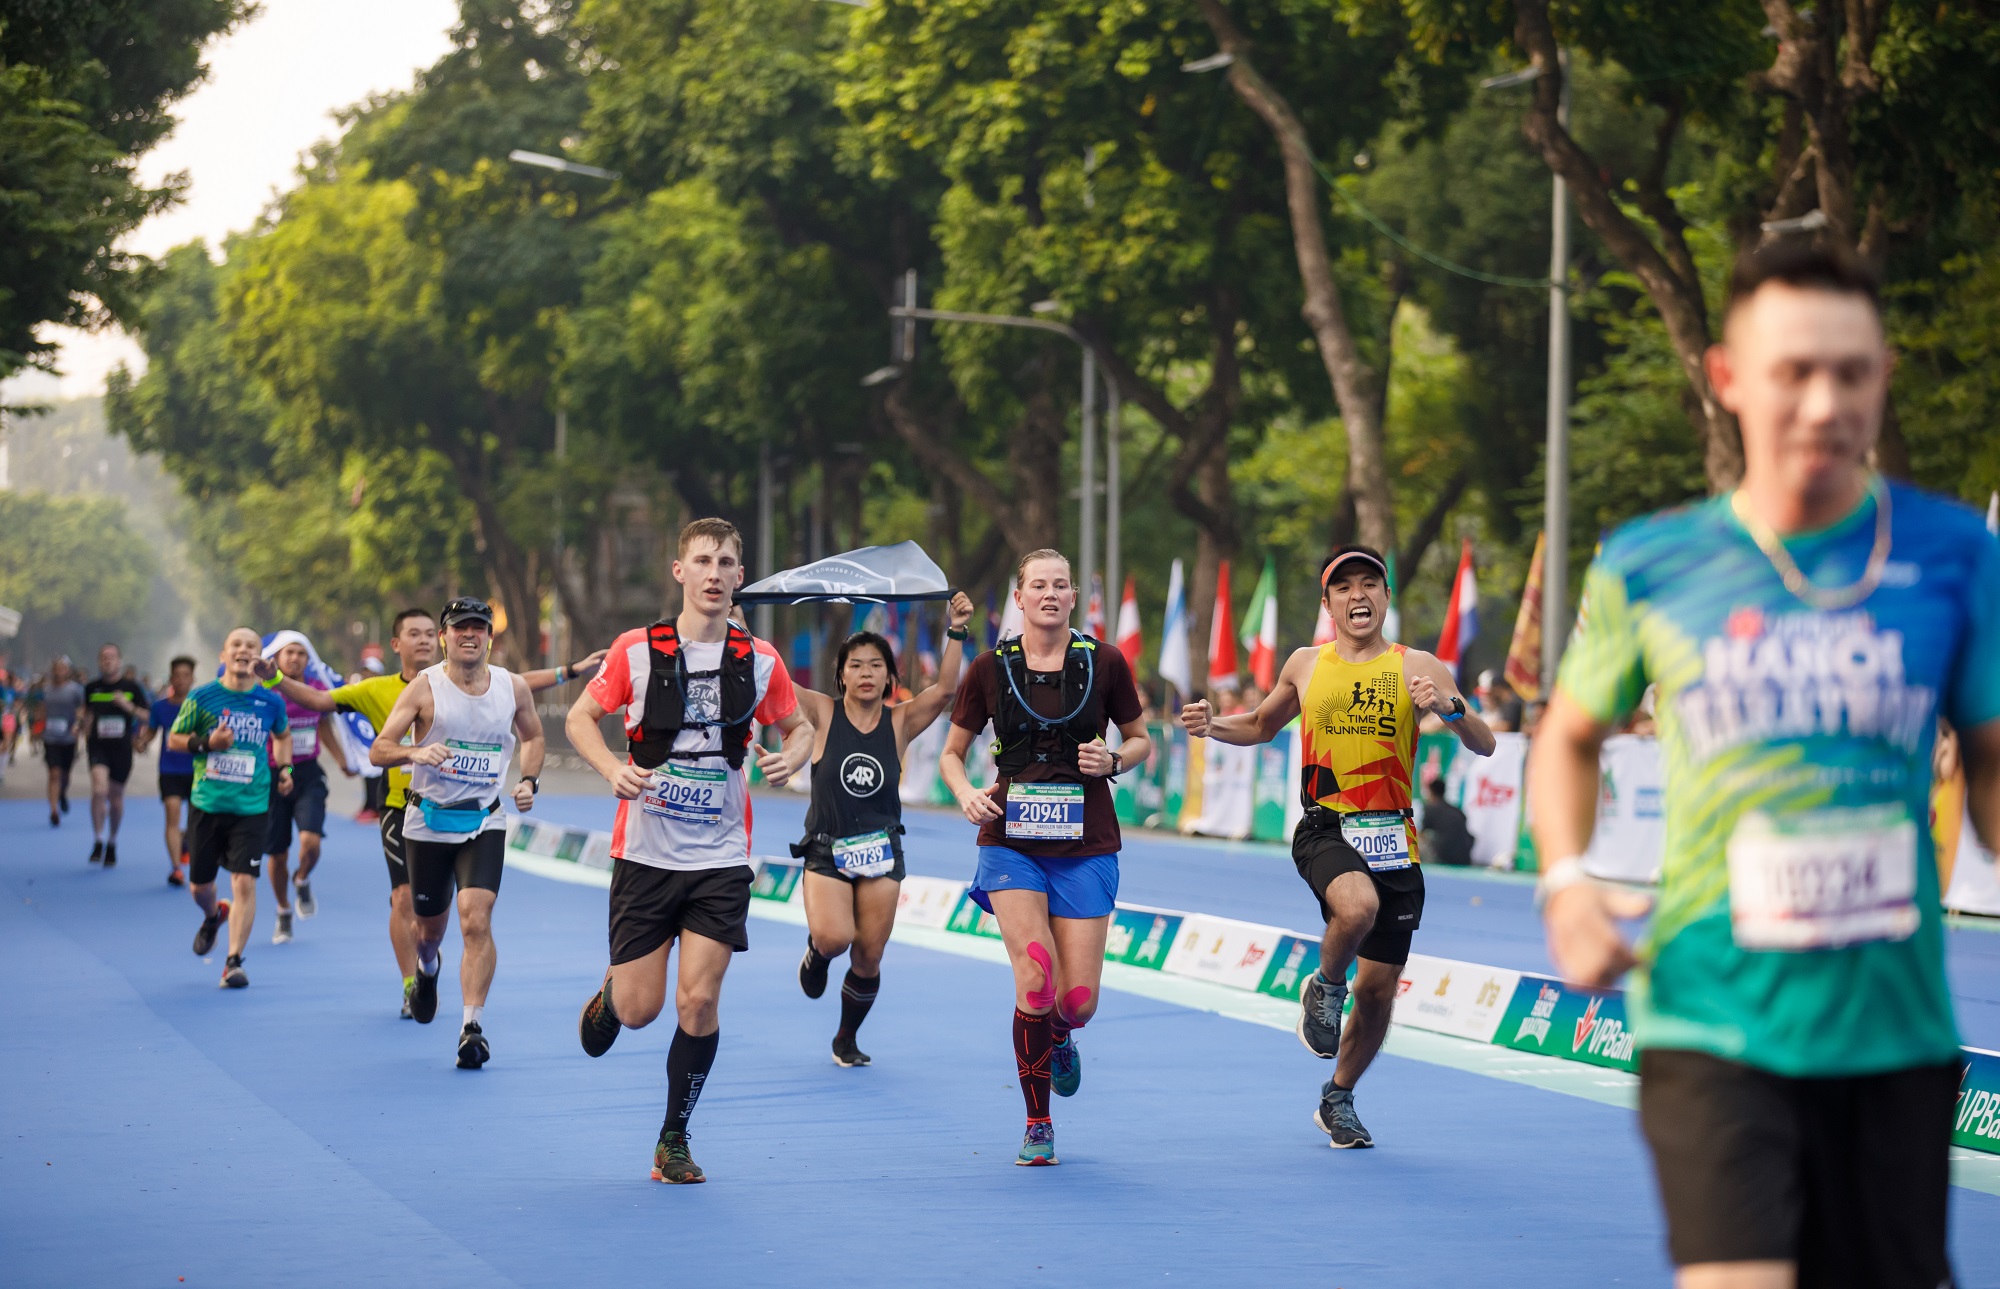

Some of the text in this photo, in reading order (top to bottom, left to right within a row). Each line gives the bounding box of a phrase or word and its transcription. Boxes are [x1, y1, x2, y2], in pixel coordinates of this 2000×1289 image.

[689, 687, 701, 698] 23
[700, 688, 716, 700] KM
[1347, 715, 1376, 723] TIME
[452, 754, 490, 772] 20713
[647, 796, 663, 806] 21KM
[658, 781, 713, 807] 20942
[1019, 802, 1069, 823] 20941
[1352, 833, 1398, 854] 20095
[843, 846, 884, 869] 20739
